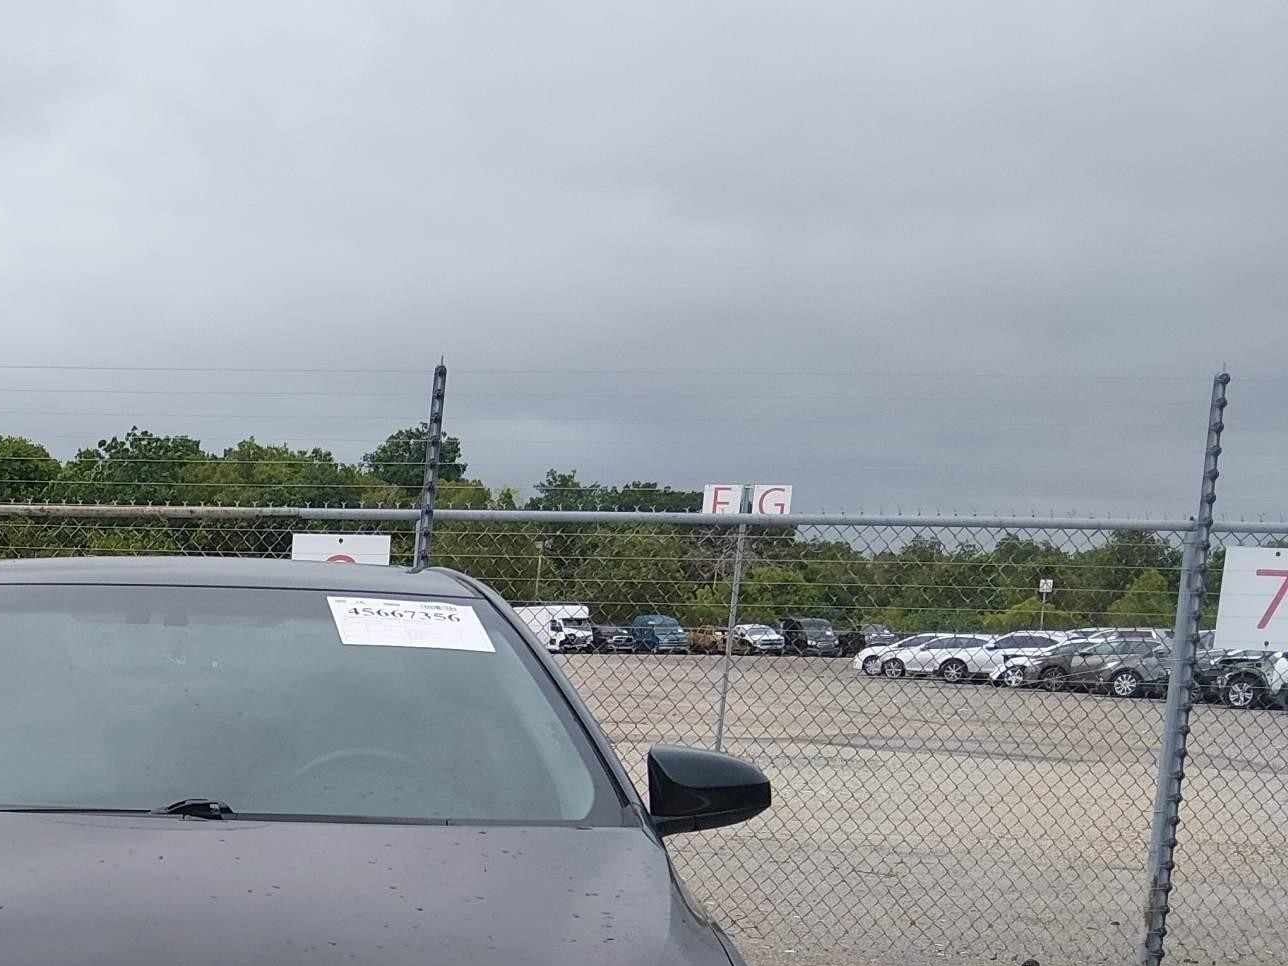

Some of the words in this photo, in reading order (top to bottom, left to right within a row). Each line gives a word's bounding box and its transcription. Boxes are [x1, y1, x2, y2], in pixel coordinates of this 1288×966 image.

[759, 487, 785, 514] G
[1256, 569, 1288, 629] 7
[347, 607, 461, 623] 45667356
